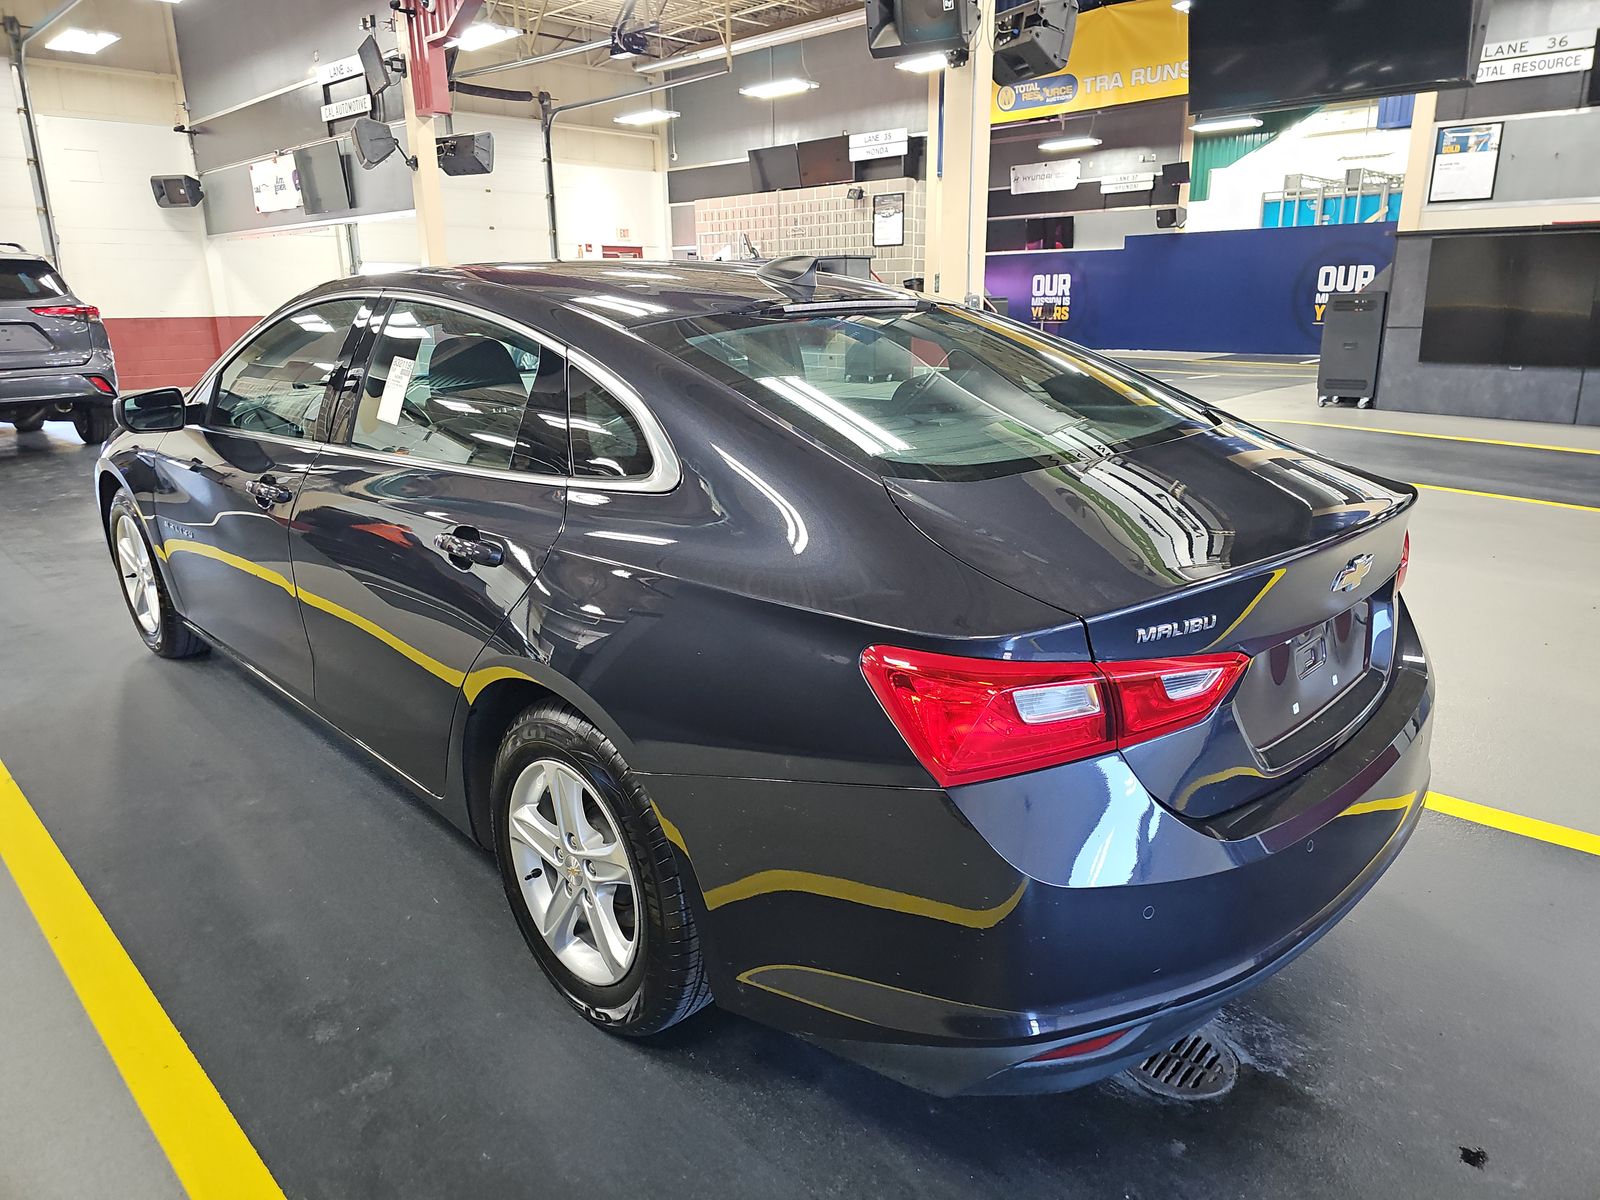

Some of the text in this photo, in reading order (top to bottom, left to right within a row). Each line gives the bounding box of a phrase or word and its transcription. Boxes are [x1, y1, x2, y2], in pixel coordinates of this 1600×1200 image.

[1484, 35, 1569, 58] LANE 36
[1512, 54, 1582, 74] RESOURCE
[1014, 82, 1040, 94] TOTAL
[1083, 72, 1124, 94] TRA
[864, 134, 880, 143] LANE
[1022, 173, 1053, 183] HYUNDAI
[1032, 273, 1071, 297] OUR
[1317, 264, 1376, 295] OUR
[1062, 296, 1071, 306] IS
[1136, 614, 1217, 644] MALIBU
